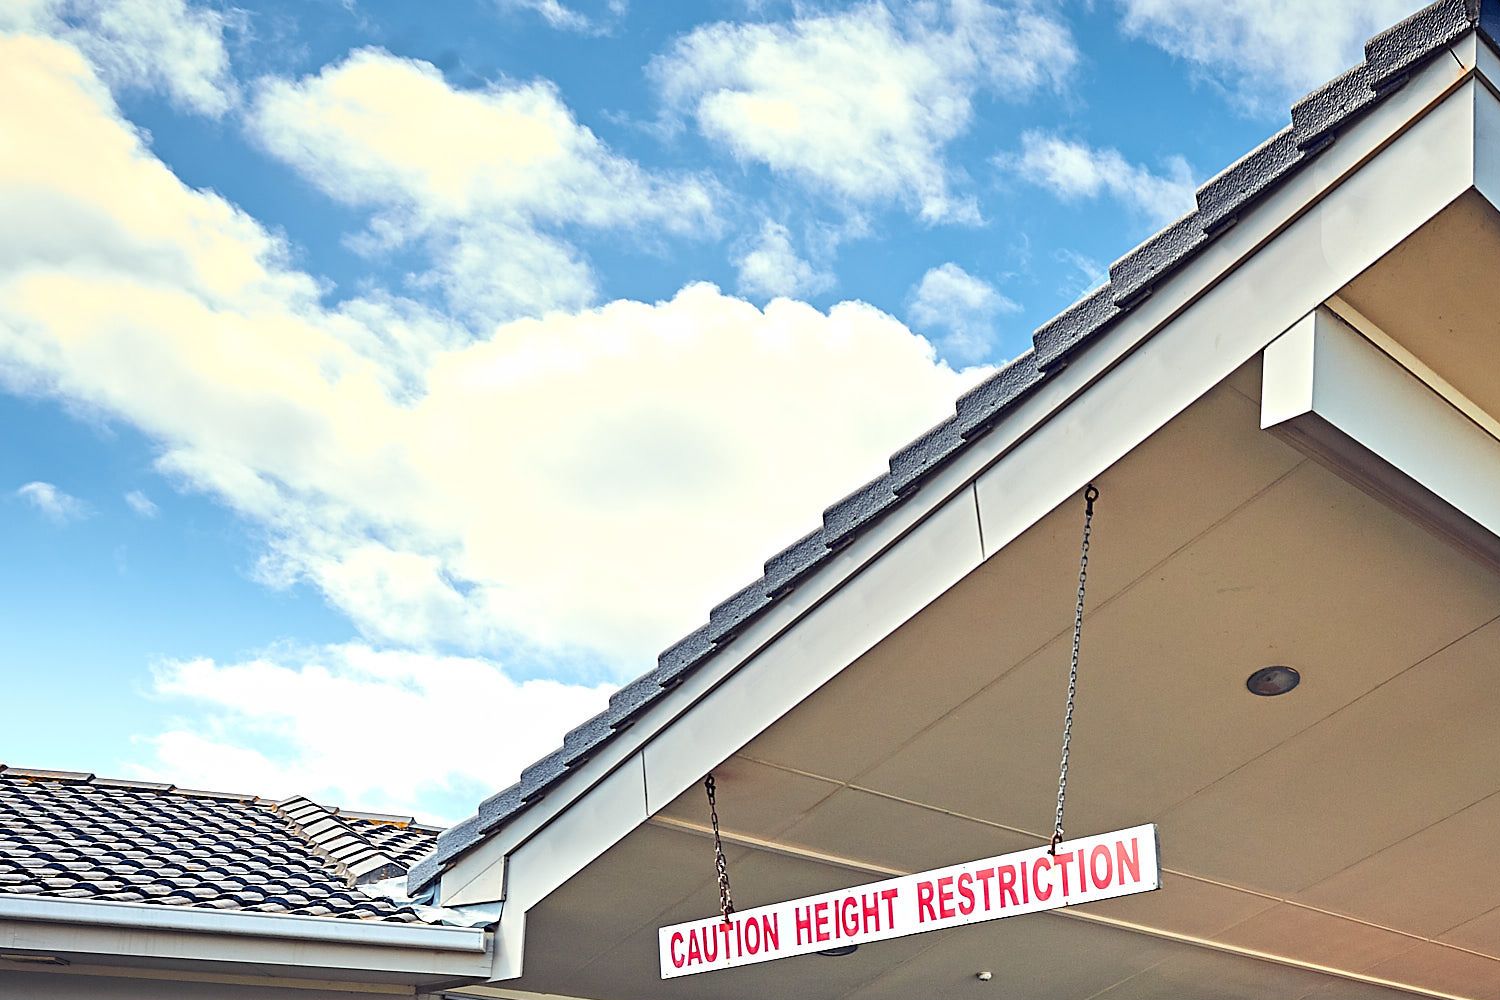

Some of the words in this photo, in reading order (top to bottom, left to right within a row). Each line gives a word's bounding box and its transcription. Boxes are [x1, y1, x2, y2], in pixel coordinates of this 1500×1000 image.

[671, 913, 779, 968] CAUTION
[795, 888, 898, 946] HEIGHT
[917, 837, 1141, 923] RESTRICTION
